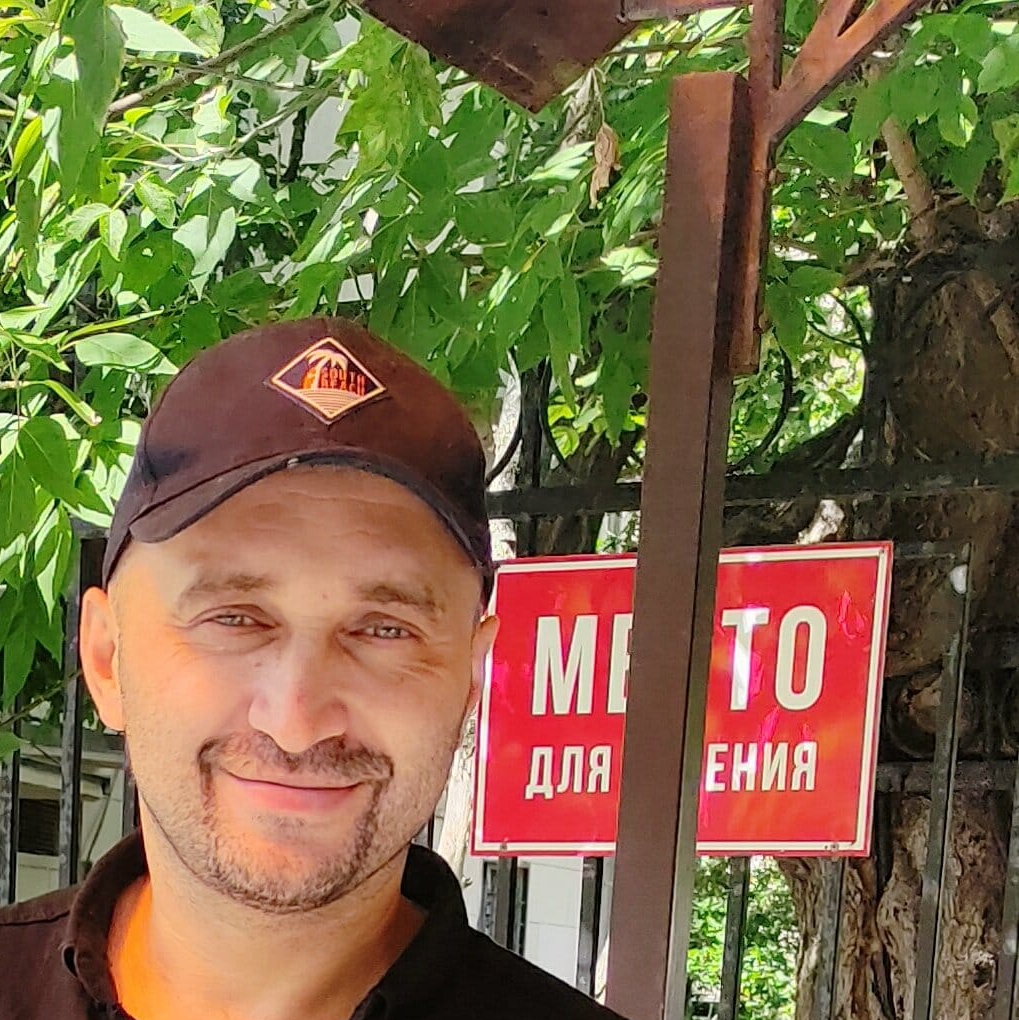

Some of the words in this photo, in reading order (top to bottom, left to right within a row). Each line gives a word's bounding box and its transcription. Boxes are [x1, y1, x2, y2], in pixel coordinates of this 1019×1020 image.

[531, 605, 827, 716] МЕТО
[524, 745, 612, 800] ДЛЯ
[704, 741, 817, 792] ЕНИЯ
